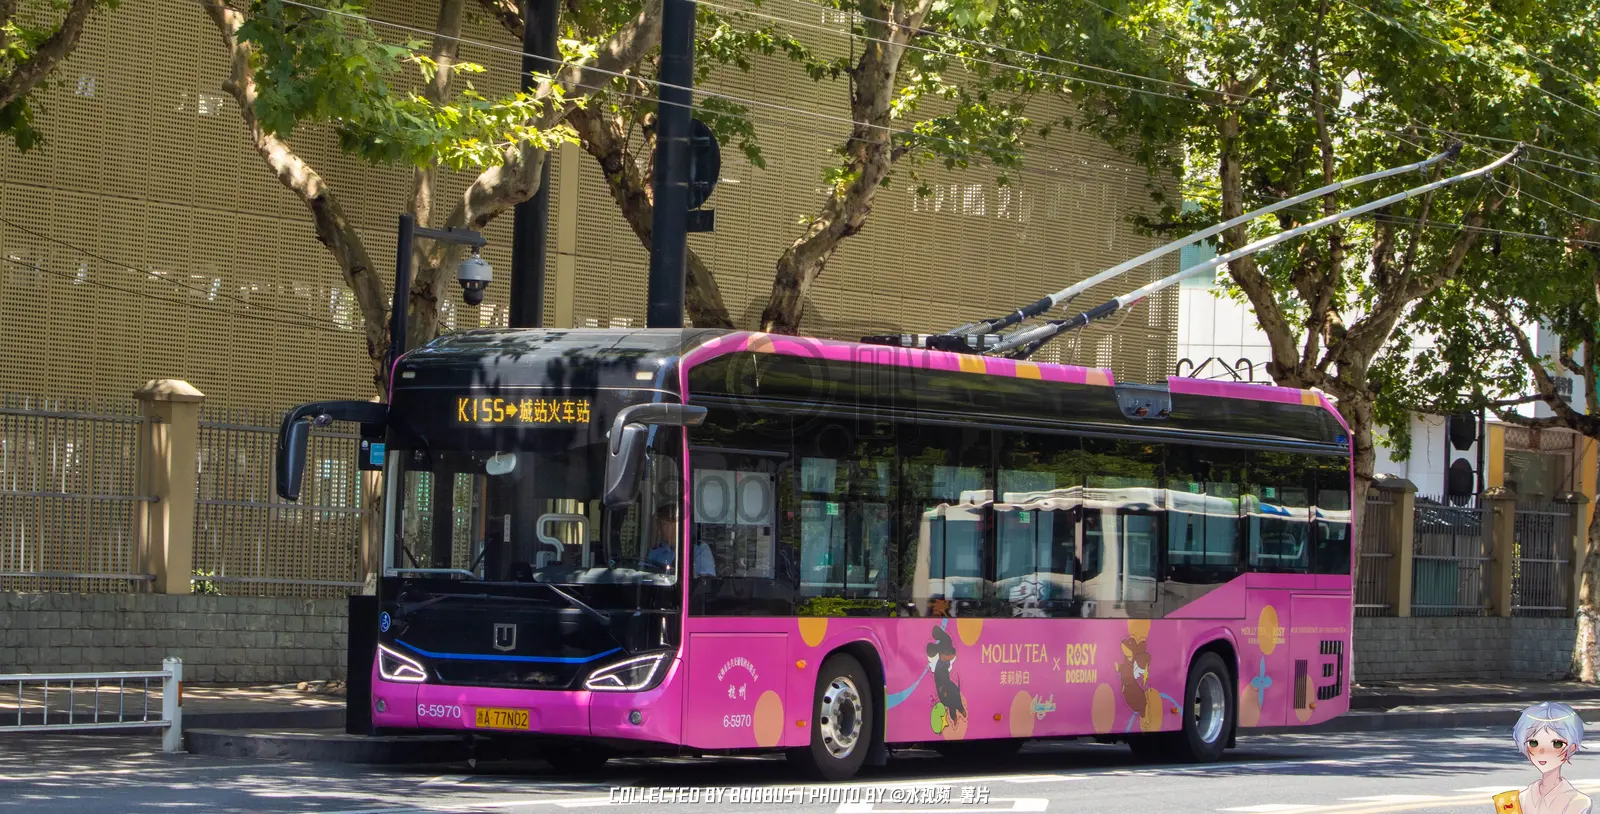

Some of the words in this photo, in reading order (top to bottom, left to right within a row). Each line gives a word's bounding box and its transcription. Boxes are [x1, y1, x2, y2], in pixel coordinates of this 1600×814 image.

[457, 397, 505, 423] KISS
[519, 398, 590, 423] 城站火车站
[981, 643, 1022, 664] MOLLY
[1024, 643, 1048, 663] TEA
[1066, 643, 1097, 666] ROSY
[1065, 669, 1097, 684] DOEDIAN
[417, 703, 461, 719] 6-5970
[723, 714, 751, 728] 6-5970
